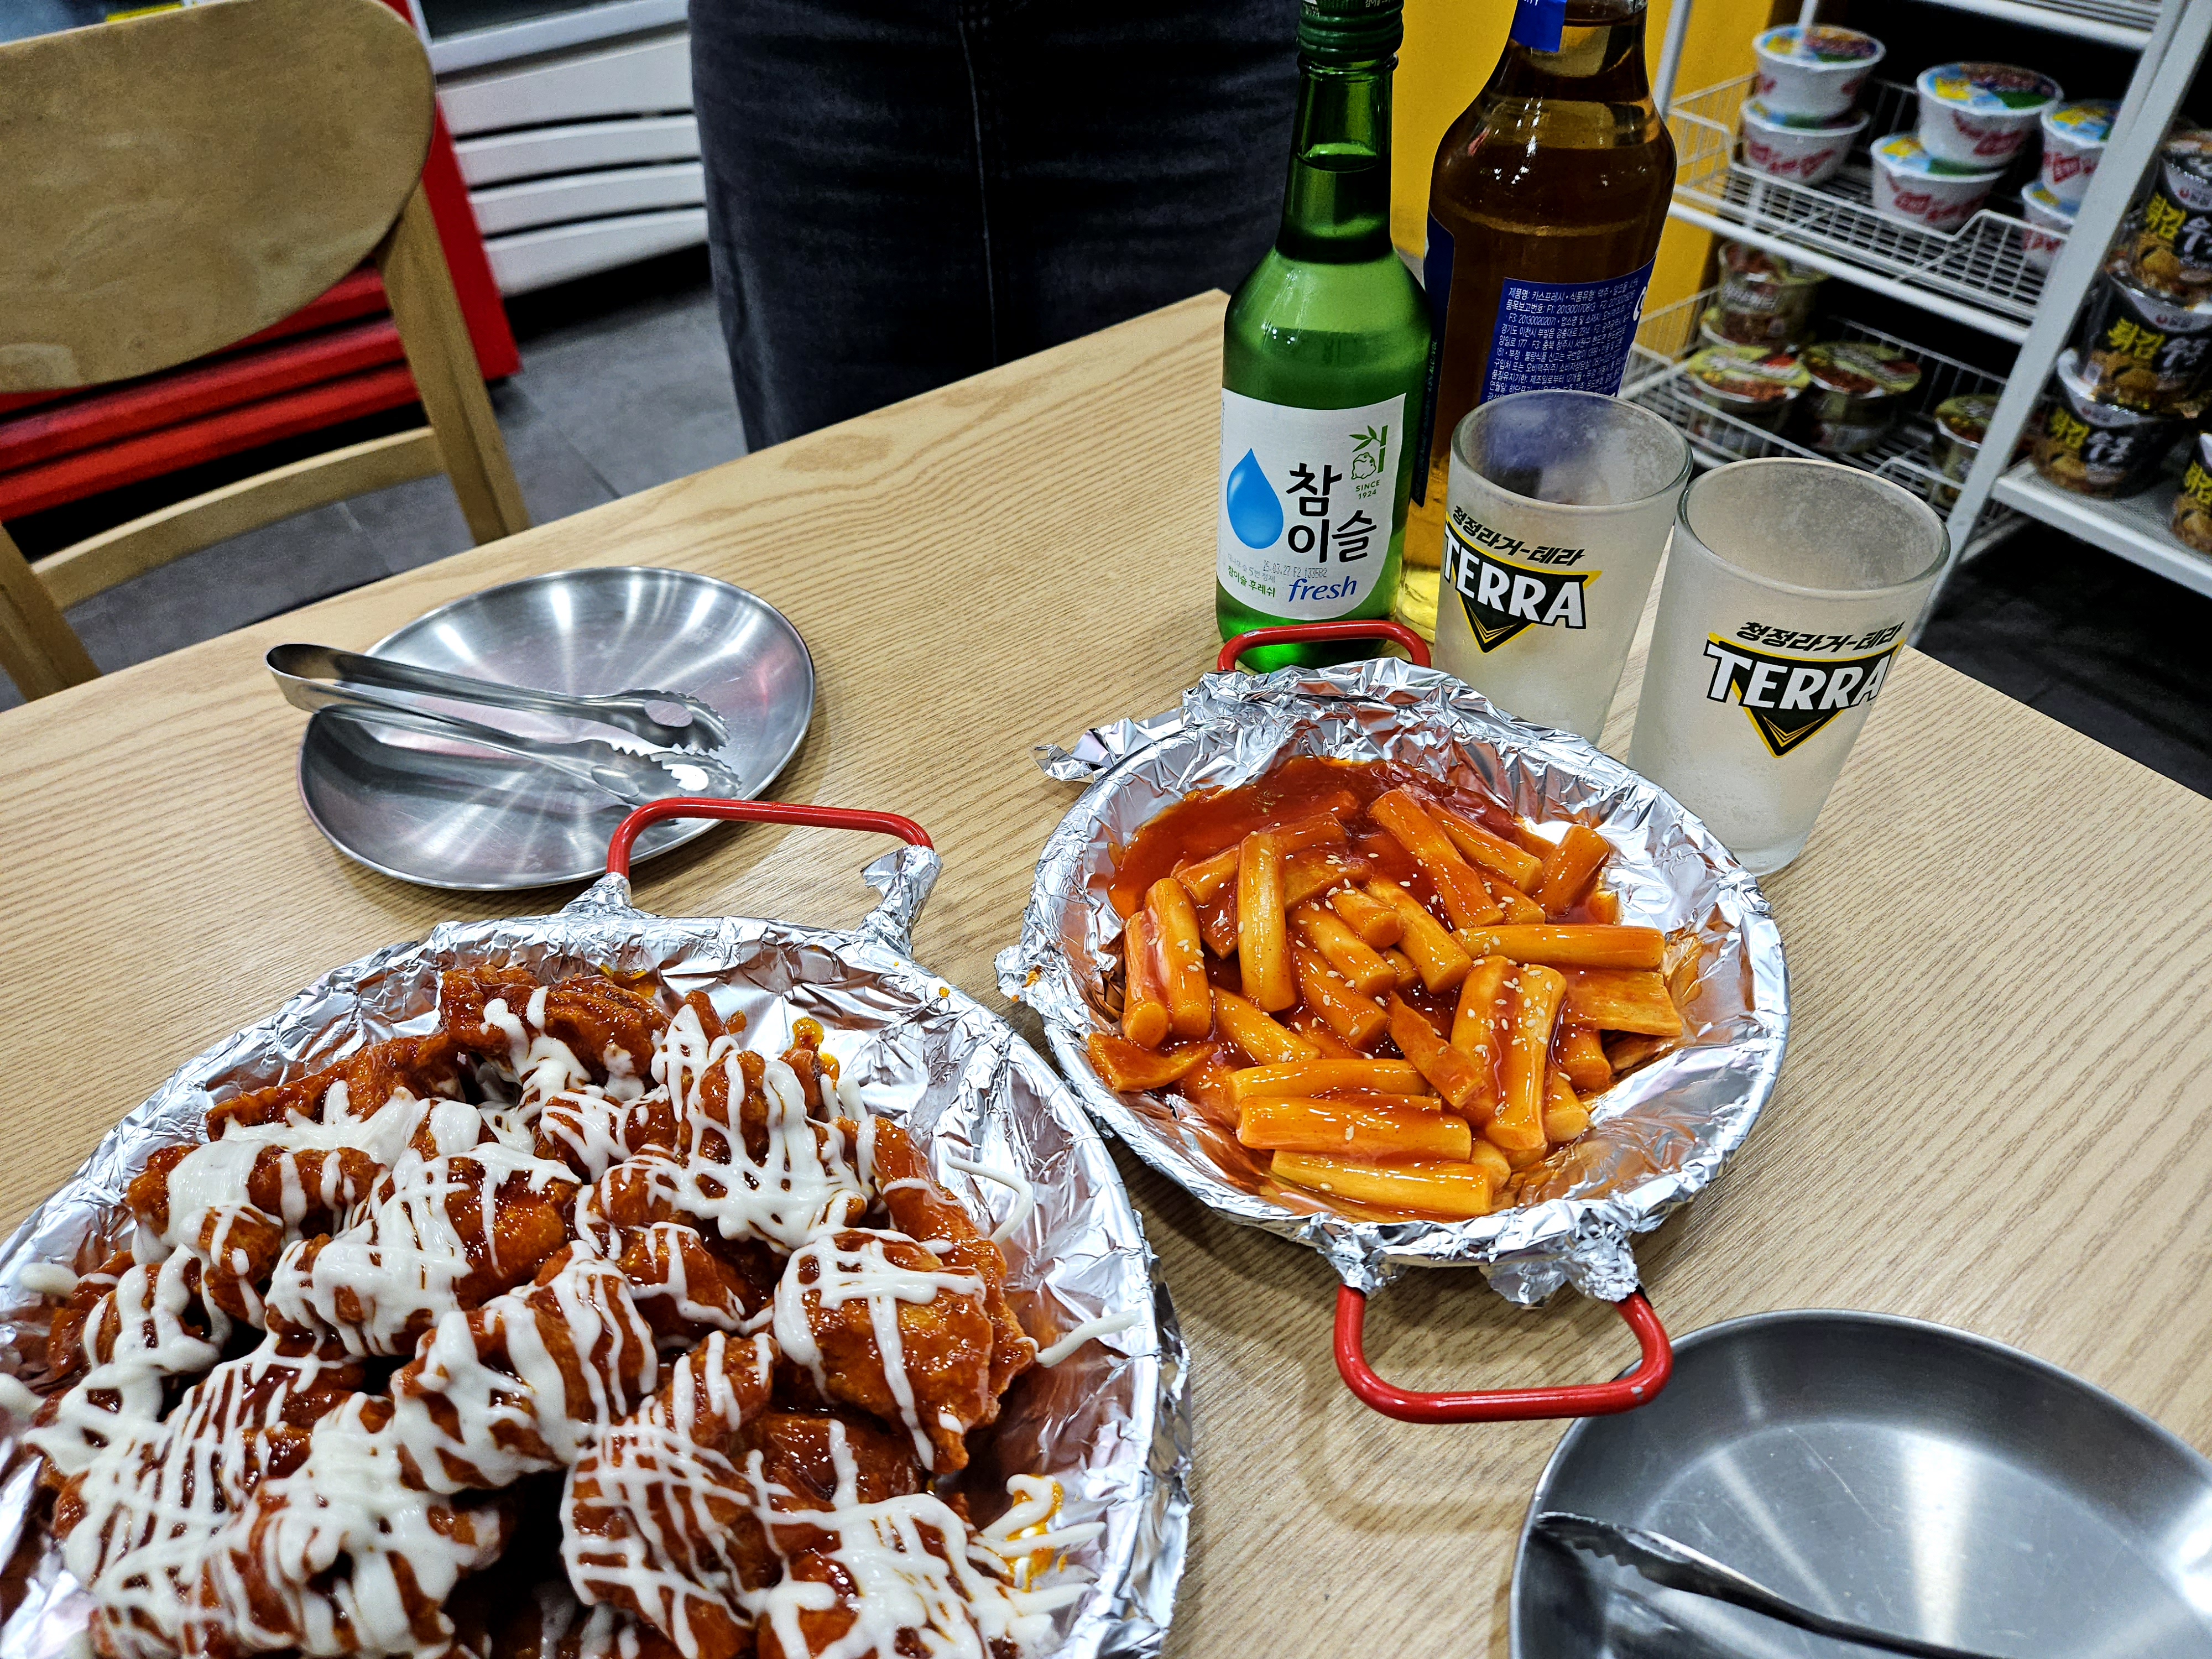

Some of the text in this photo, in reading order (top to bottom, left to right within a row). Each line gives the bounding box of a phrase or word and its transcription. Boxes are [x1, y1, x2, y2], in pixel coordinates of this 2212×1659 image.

[1509, 287, 1530, 300] 제품명:
[1531, 290, 1565, 303] 카스프레시
[1561, 316, 1578, 327] 업소명
[1501, 324, 1518, 335] 경기도
[1519, 326, 1537, 338] 이천시
[1499, 335, 1516, 347] 양일로
[1542, 340, 1554, 351] 충북
[1556, 339, 1574, 351] 청주시
[1509, 349, 1521, 361] 부정
[1525, 351, 1547, 362] 불량식품
[1494, 358, 1512, 371] 구입처
[1512, 361, 1524, 372] 또는
[1530, 374, 1565, 385] 제조일로부터
[1286, 462, 1343, 517] 참
[1355, 479, 1380, 492] SINCE
[1358, 489, 1376, 500] 1924
[1287, 509, 1378, 564] 이슬
[1453, 505, 1585, 566] 청정라거-테라
[1228, 565, 1275, 598] 참이슬 후레쉬
[1249, 566, 1261, 578] 5번
[1261, 572, 1275, 584] 정제
[1444, 523, 1585, 628] TERRA
[1288, 576, 1357, 602] fresh
[1736, 621, 1906, 653] 청정라거-테라
[1705, 641, 1891, 711] TERRA
